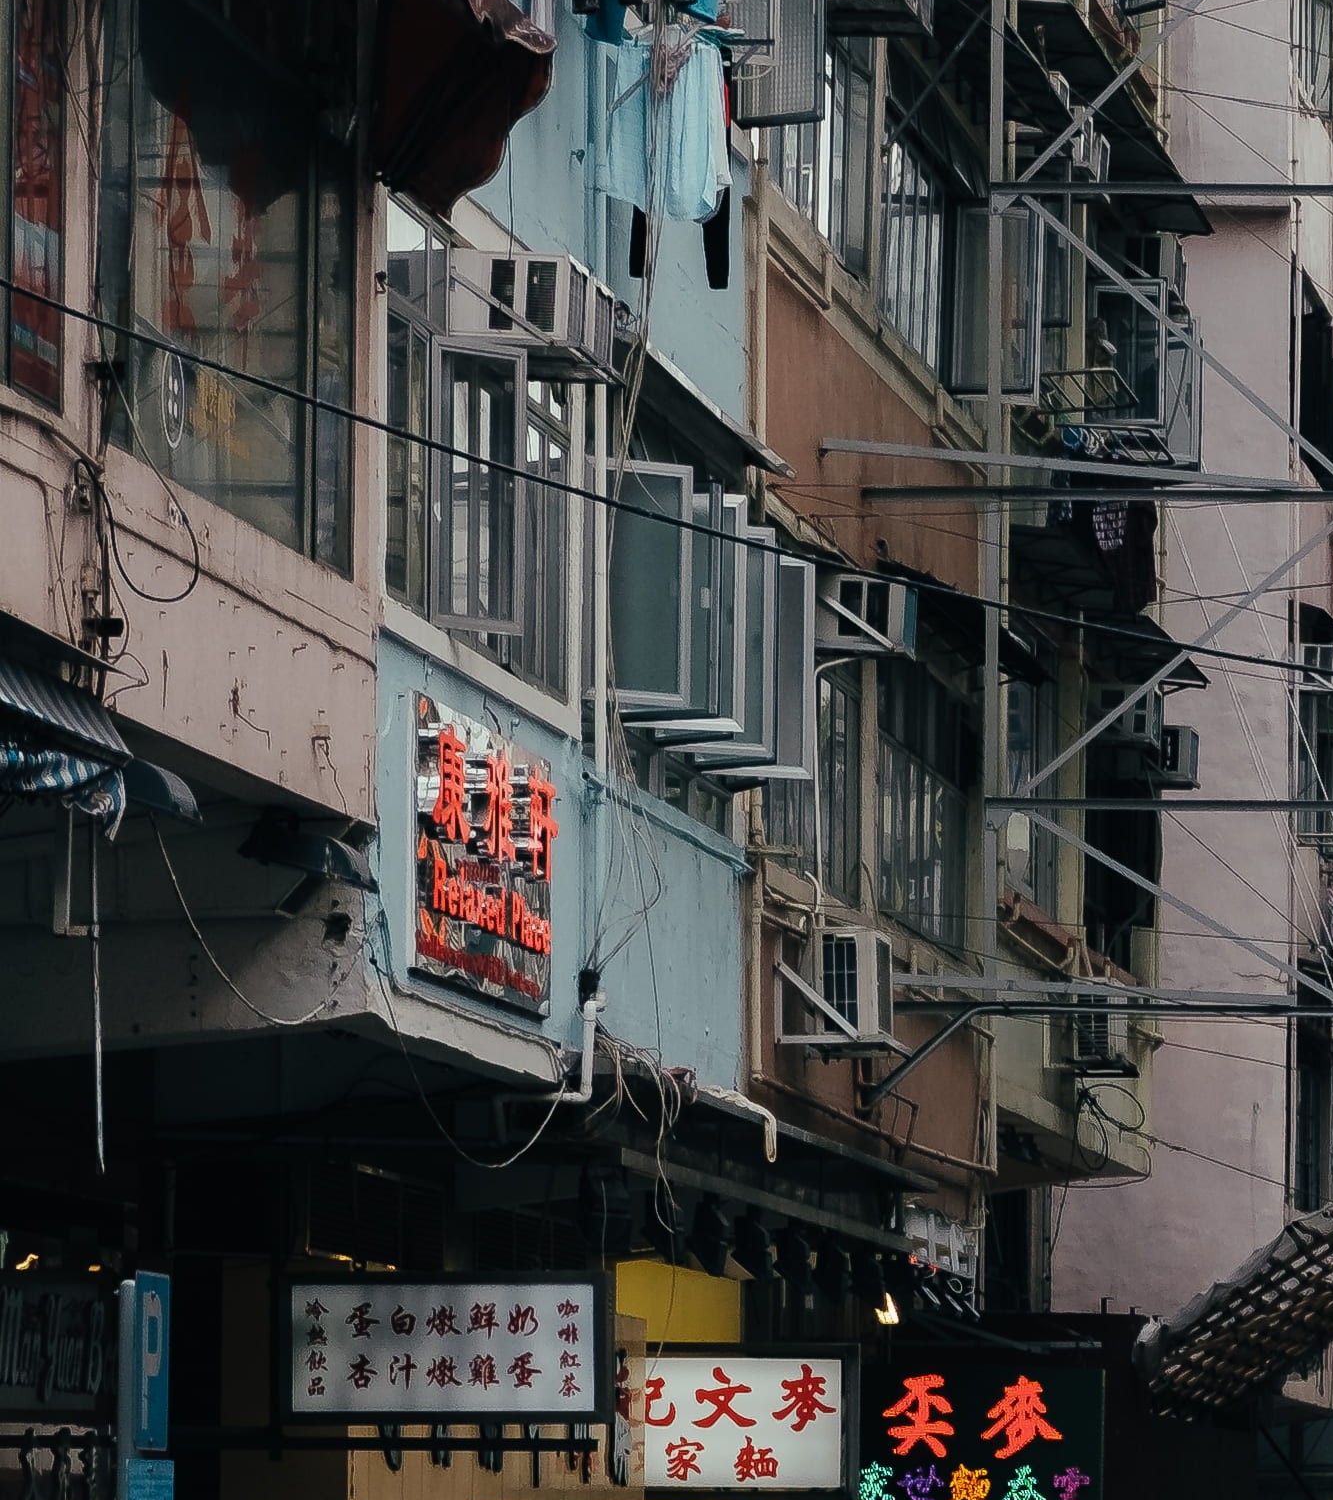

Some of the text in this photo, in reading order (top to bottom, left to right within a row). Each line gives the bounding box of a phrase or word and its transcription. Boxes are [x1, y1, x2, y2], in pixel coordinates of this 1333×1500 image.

[433, 859, 552, 954] Relaxed Place
[305, 1298, 330, 1397] 冷熱飲品
[345, 1302, 540, 1340] 蛋白燉鮮奶
[557, 1298, 581, 1398] 咖啡紅茶
[346, 1352, 543, 1391] 杏汁燉雞蛋
[665, 1437, 778, 1482] 麵家
